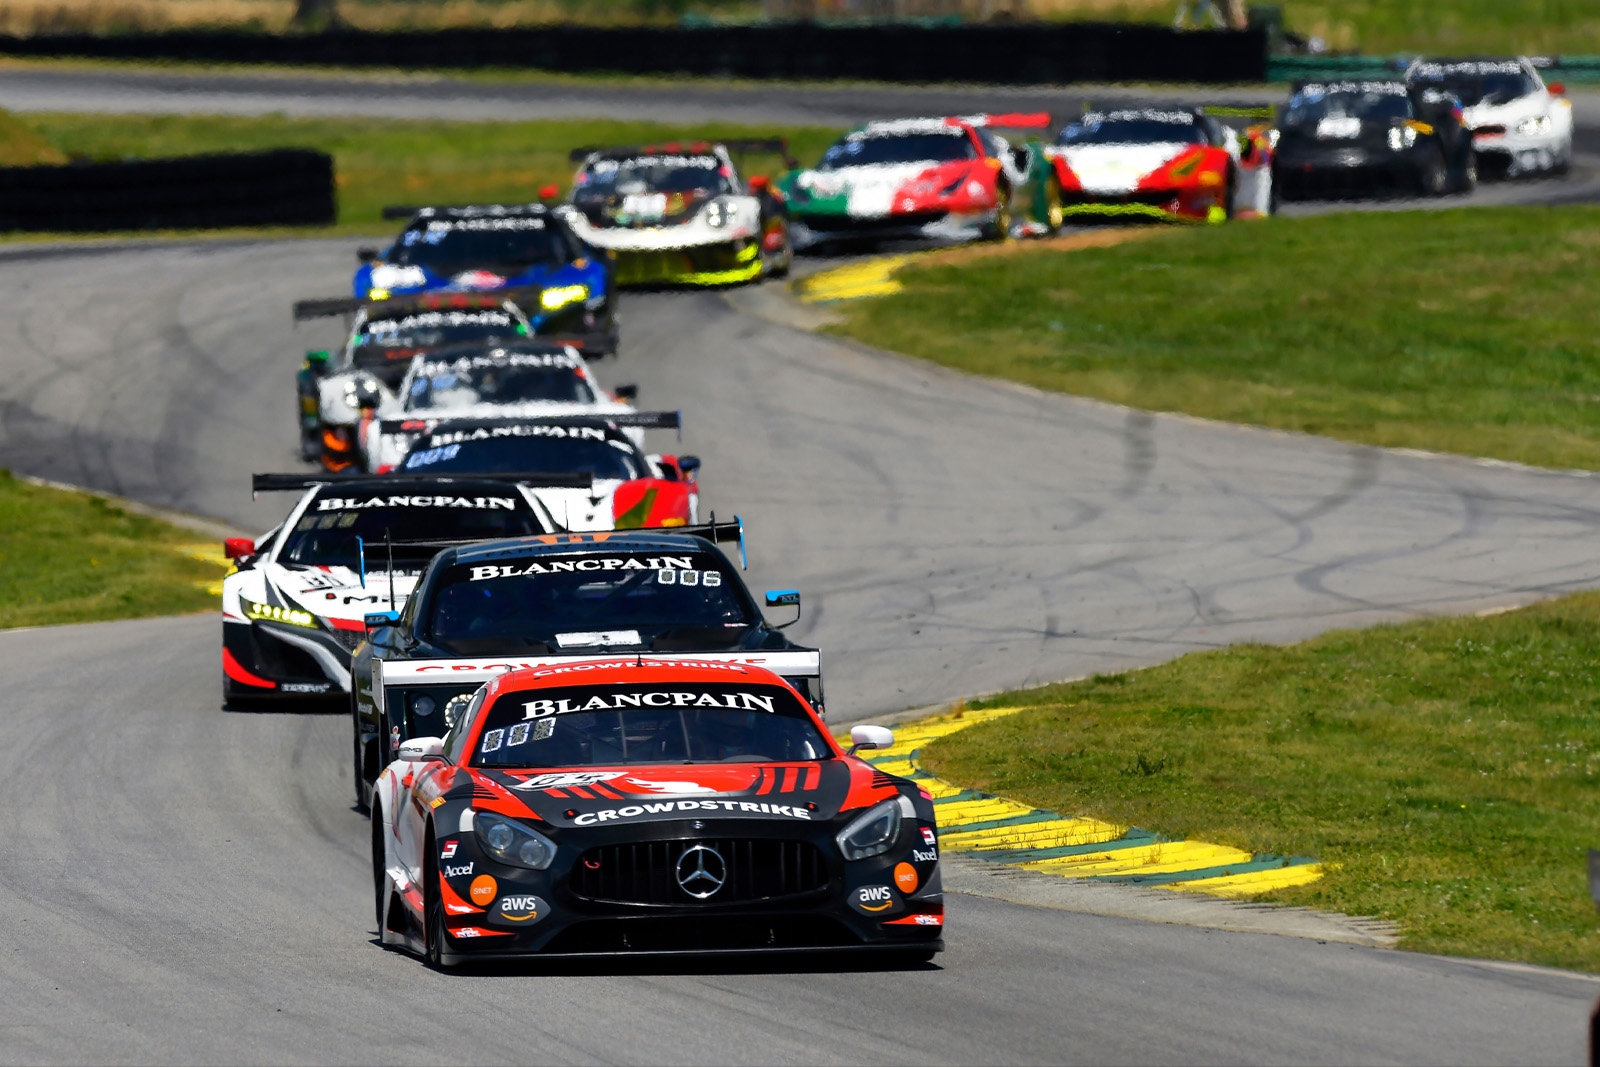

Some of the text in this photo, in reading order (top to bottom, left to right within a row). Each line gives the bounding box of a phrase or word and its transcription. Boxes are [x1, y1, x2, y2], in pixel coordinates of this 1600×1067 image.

[317, 496, 516, 511] BLANCPAIN
[470, 556, 692, 581] BLANCPAIN
[658, 569, 721, 586] 006
[533, 660, 746, 676] CROWDSTRIKE
[521, 692, 774, 720] BLANCPAIN
[574, 801, 811, 826] CROWDSTRIKE
[913, 847, 937, 862] Accel
[444, 862, 474, 878] Accel
[860, 887, 891, 901] aws
[502, 897, 535, 911] aws
